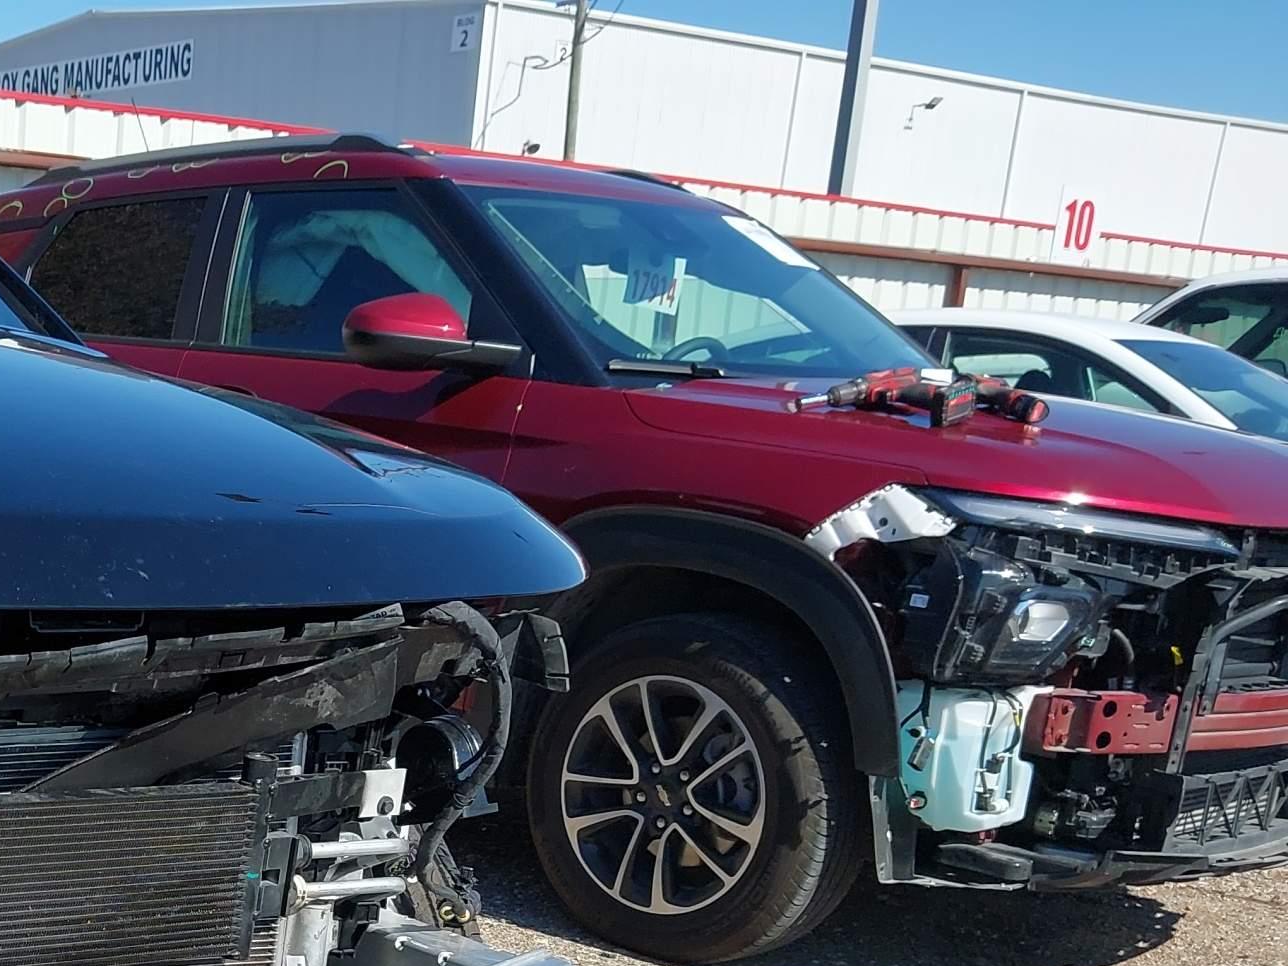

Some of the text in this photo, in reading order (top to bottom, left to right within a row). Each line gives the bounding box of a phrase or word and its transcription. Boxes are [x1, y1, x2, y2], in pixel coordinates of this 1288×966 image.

[459, 29, 469, 48] 2
[22, 65, 59, 96] GANG
[63, 43, 192, 93] MANUFACTURING
[1064, 199, 1095, 250] 10
